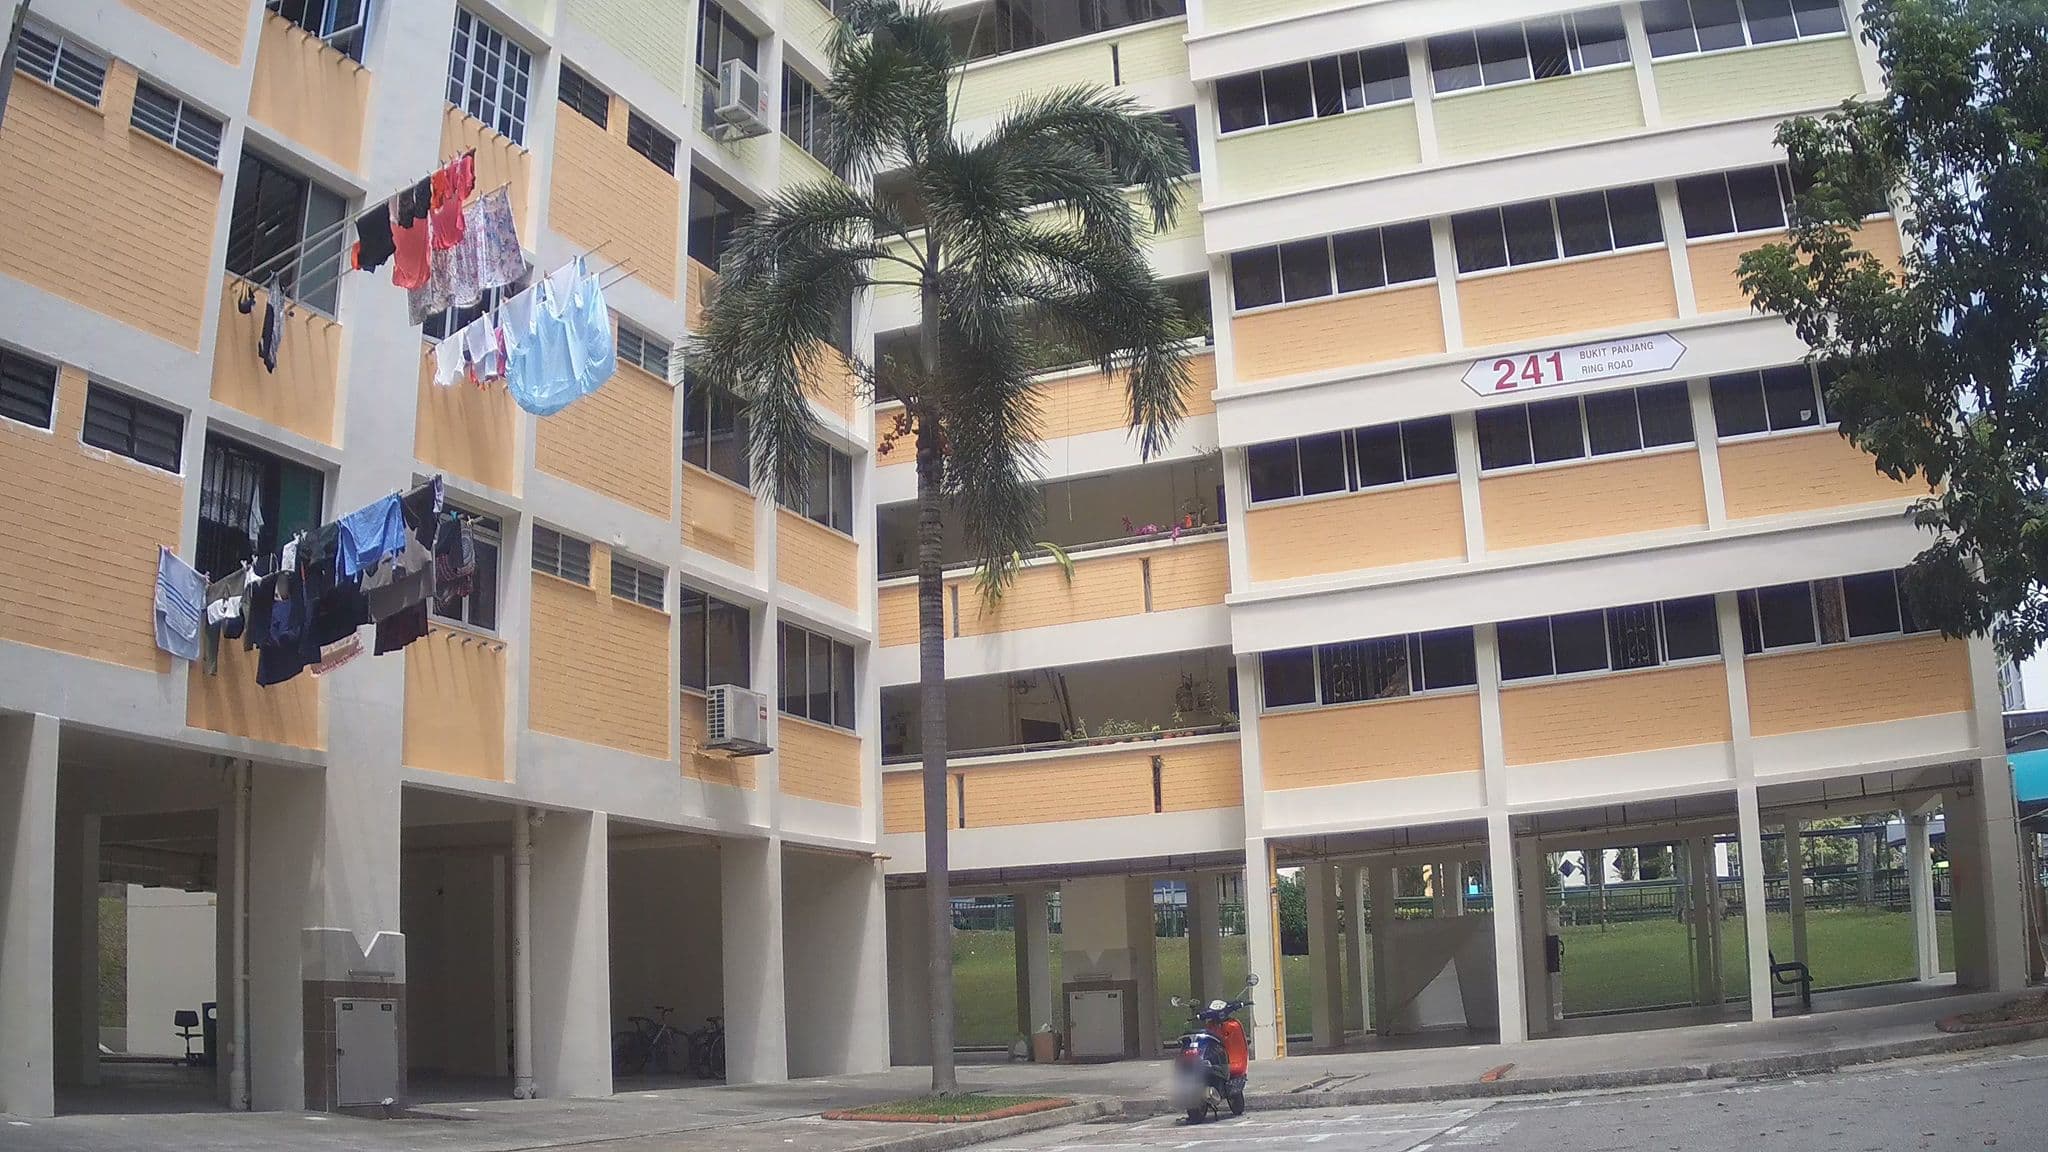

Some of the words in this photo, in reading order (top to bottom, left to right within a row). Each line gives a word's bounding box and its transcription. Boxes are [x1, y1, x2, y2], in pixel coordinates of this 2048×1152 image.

[1579, 347, 1607, 360] BUKIT
[1611, 341, 1655, 356] PANJANG
[1492, 351, 1564, 391] 241
[1581, 363, 1604, 375] RING
[1607, 359, 1634, 371] ROAD
